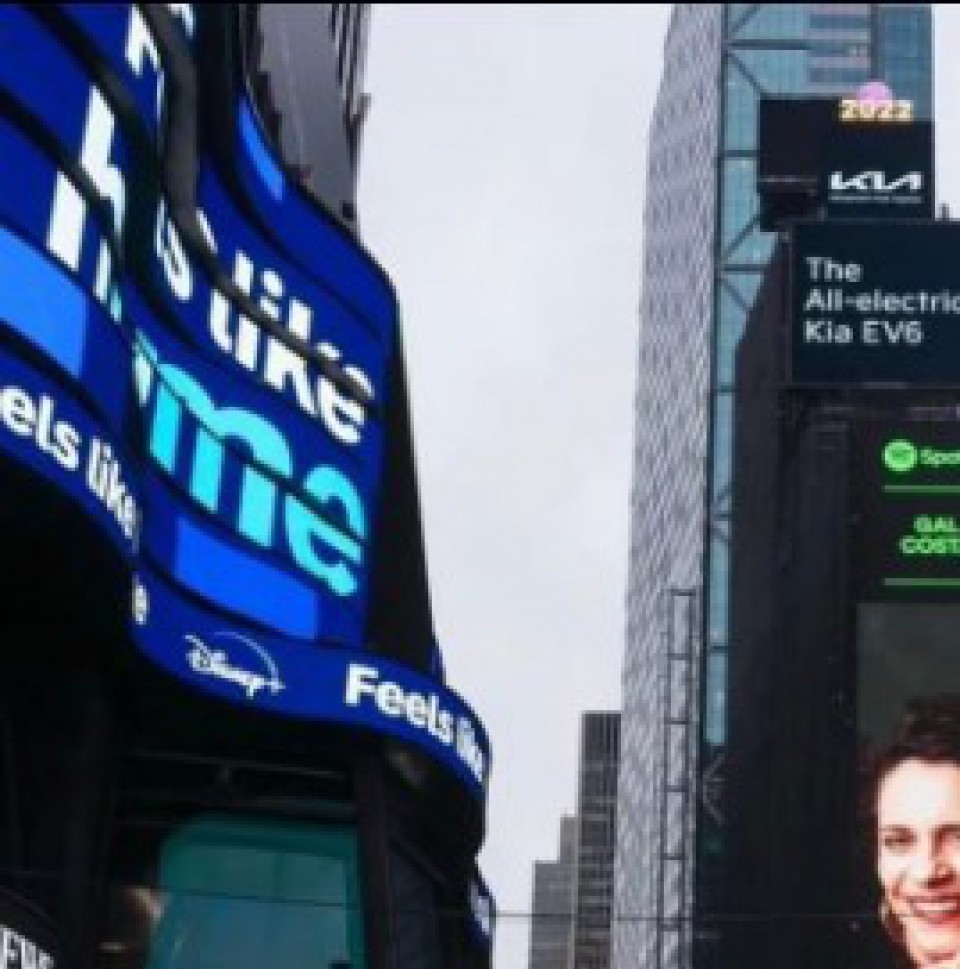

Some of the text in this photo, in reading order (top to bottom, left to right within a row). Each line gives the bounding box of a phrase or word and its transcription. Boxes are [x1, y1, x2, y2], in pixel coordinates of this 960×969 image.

[804, 256, 863, 283] The
[803, 320, 925, 344] Kia EV6
[913, 514, 960, 533] GAL
[343, 662, 453, 746] Feels
